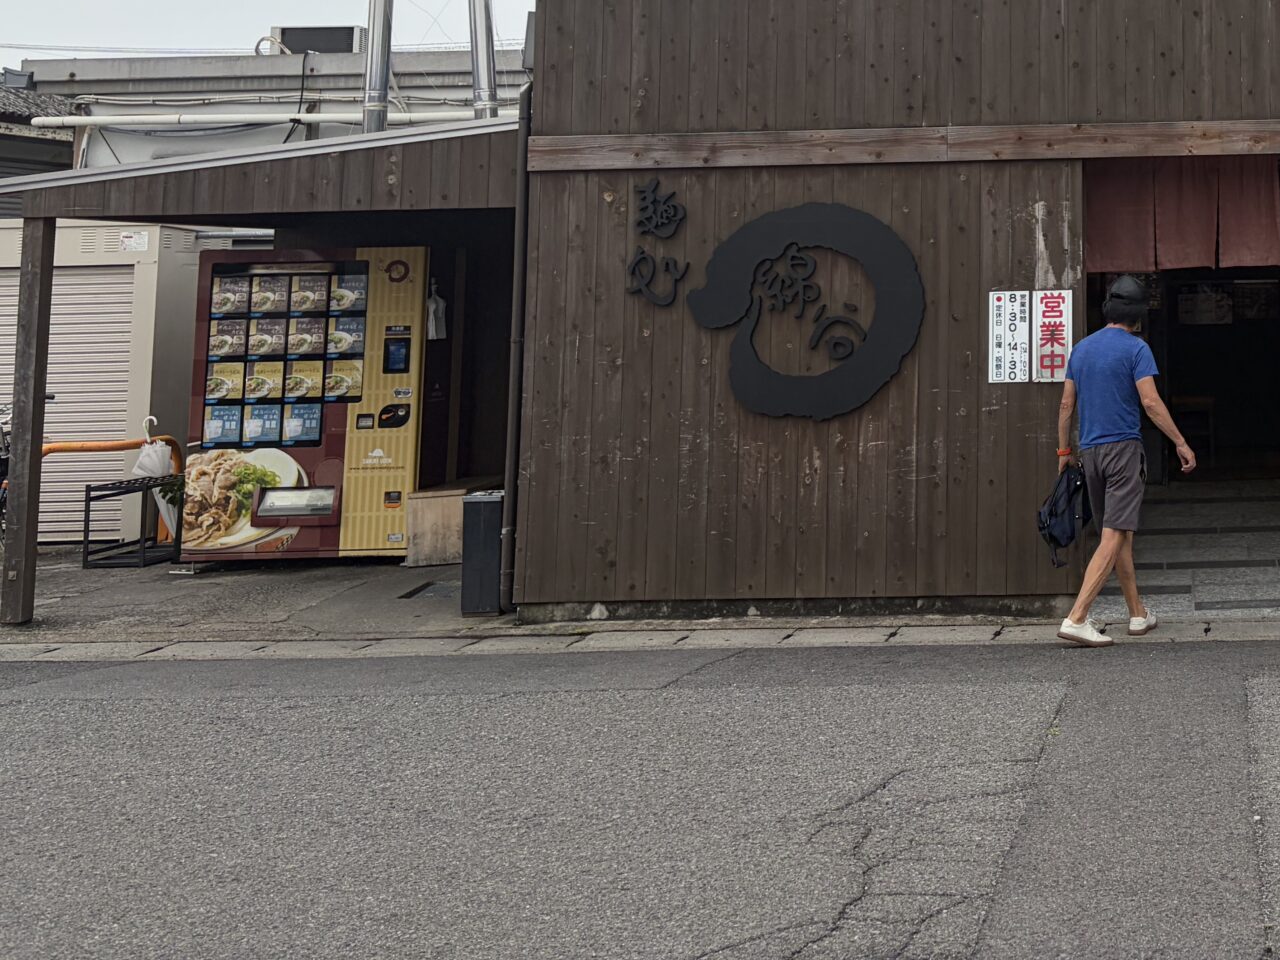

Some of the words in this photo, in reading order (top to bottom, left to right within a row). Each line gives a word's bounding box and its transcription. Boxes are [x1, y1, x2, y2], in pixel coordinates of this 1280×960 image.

[995, 305, 1003, 326] 定休日
[1019, 294, 1027, 323] 営業時間
[1040, 292, 1065, 379] 営業中
